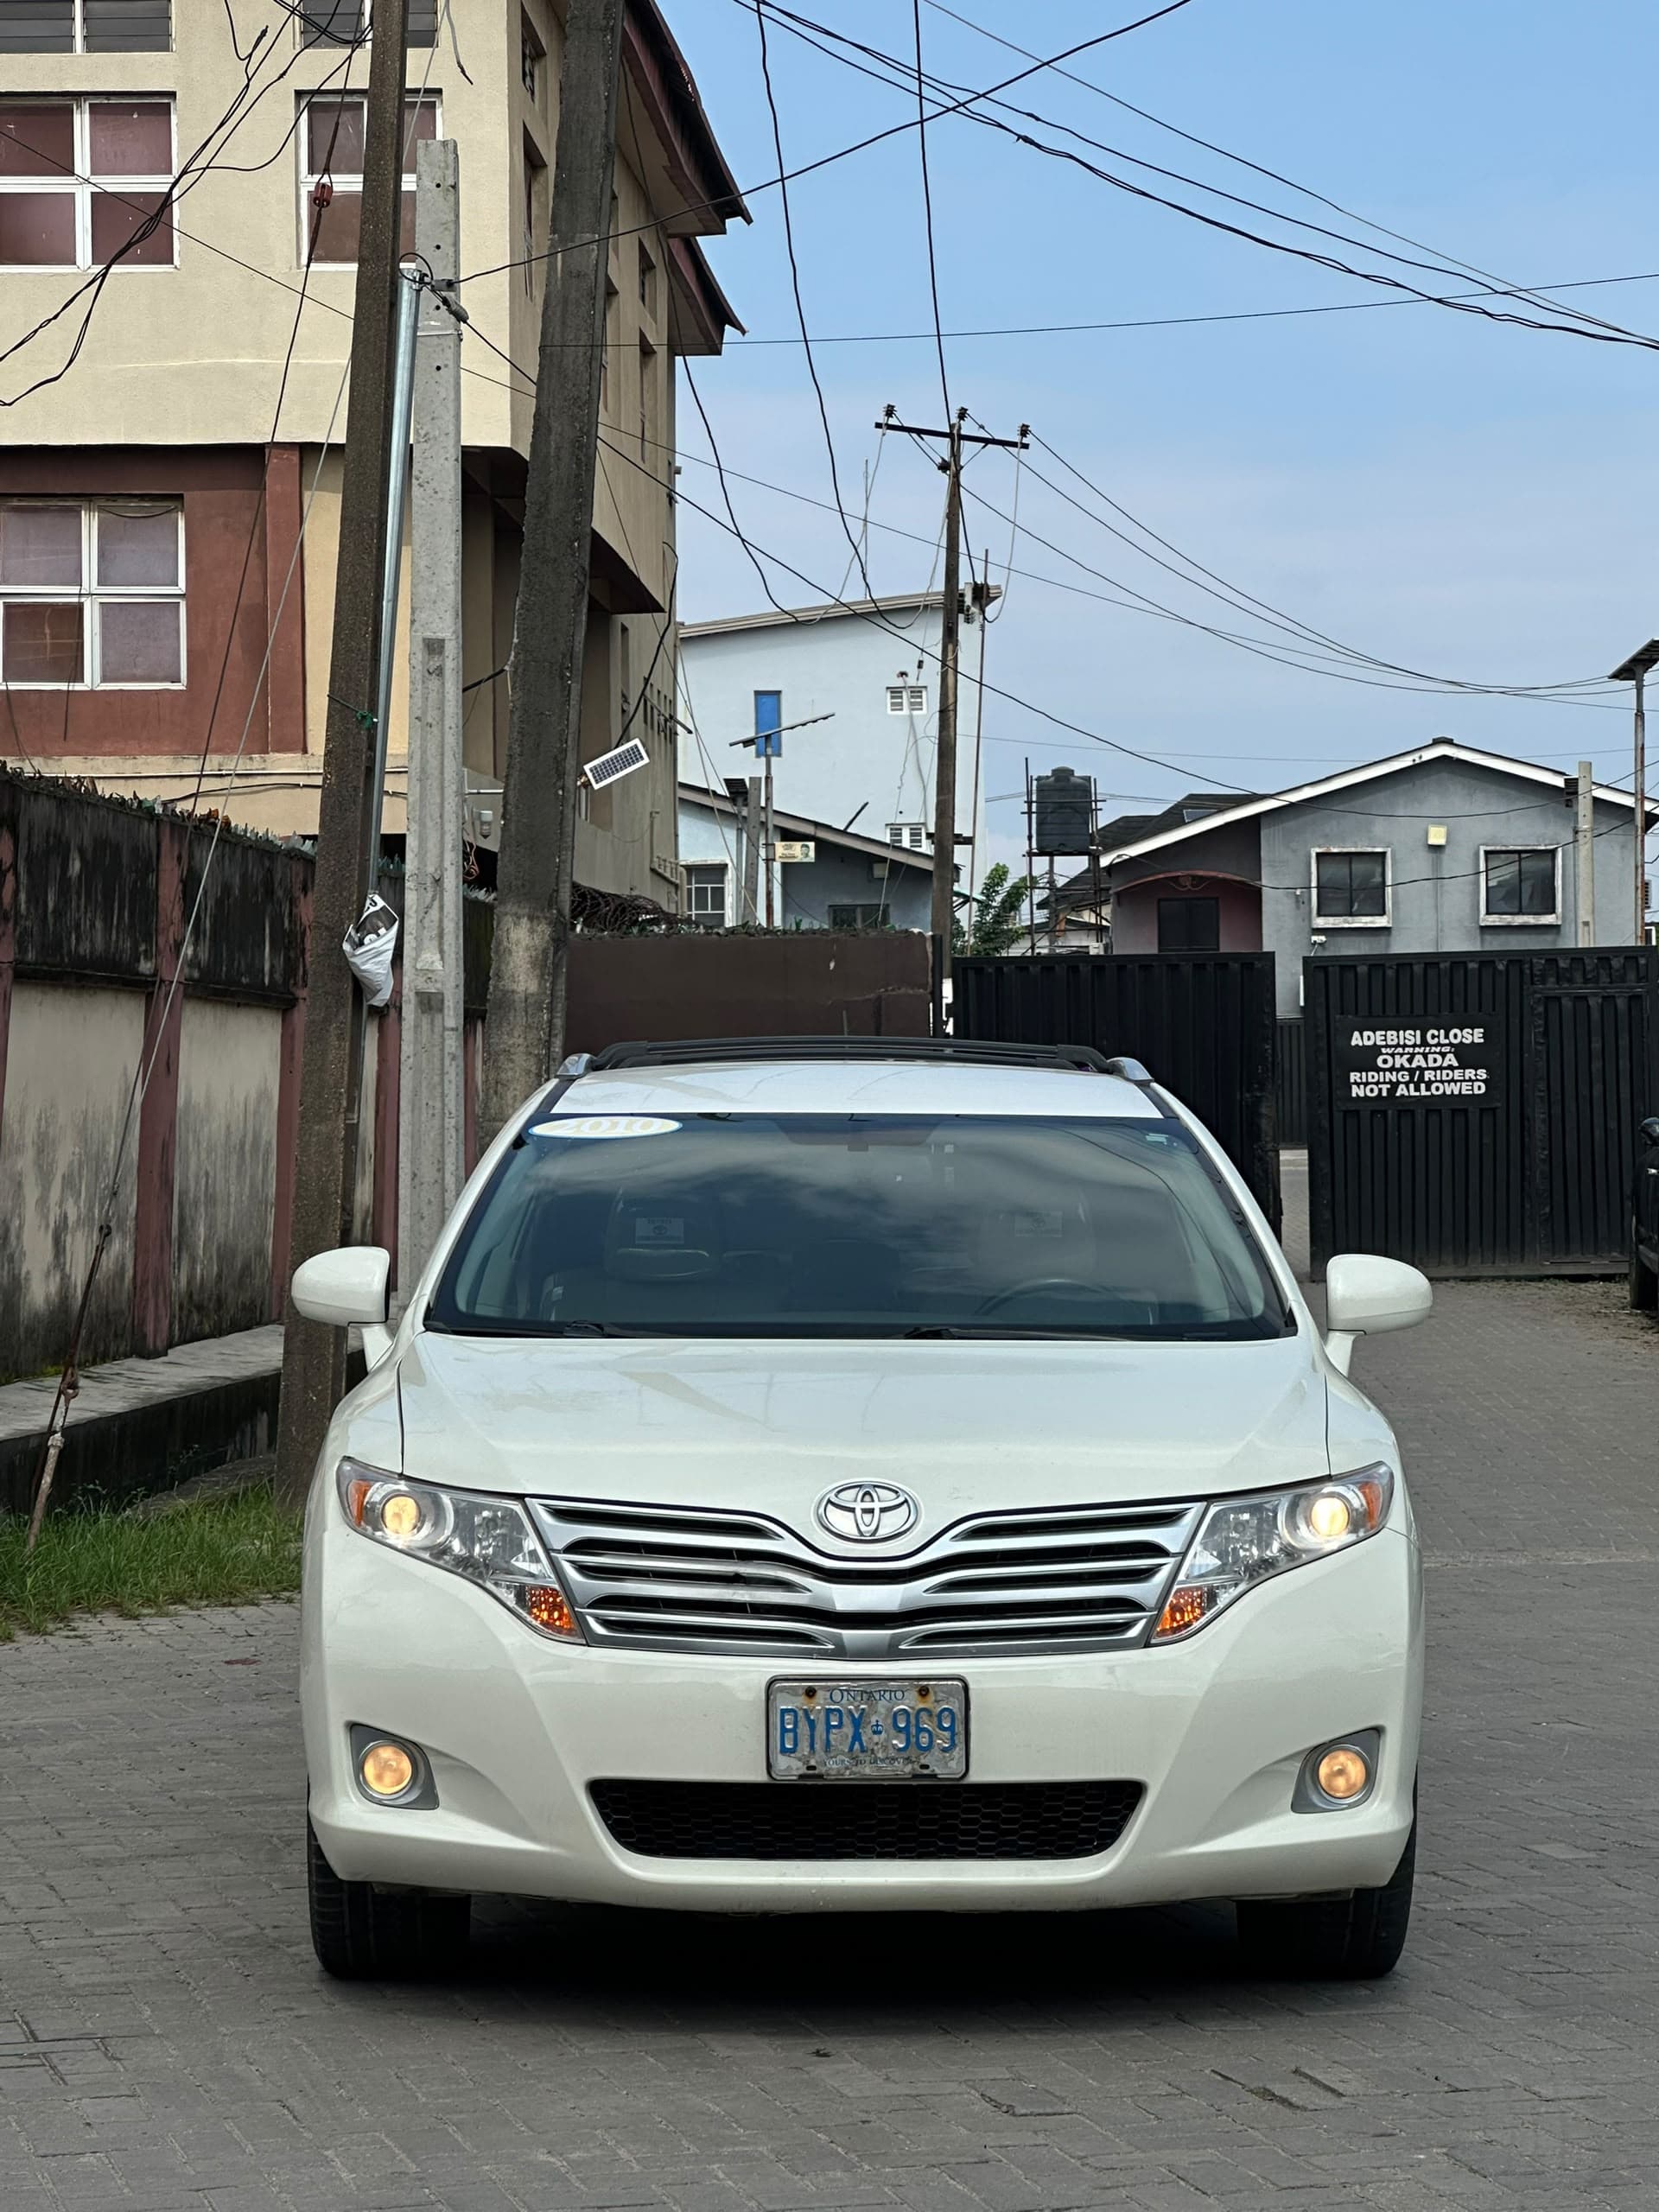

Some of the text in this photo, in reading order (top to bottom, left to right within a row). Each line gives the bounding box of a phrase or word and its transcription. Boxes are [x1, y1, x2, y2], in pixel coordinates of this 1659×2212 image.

[1351, 1028, 1484, 1046] ADEBISI CLOSE
[1376, 1053, 1459, 1068] OKADA
[1350, 1071, 1409, 1083] RIDING
[1351, 1082, 1486, 1097] NOT ALLOWED
[556, 1119, 663, 1135] 2010
[779, 1705, 956, 1754] BYPX 969
